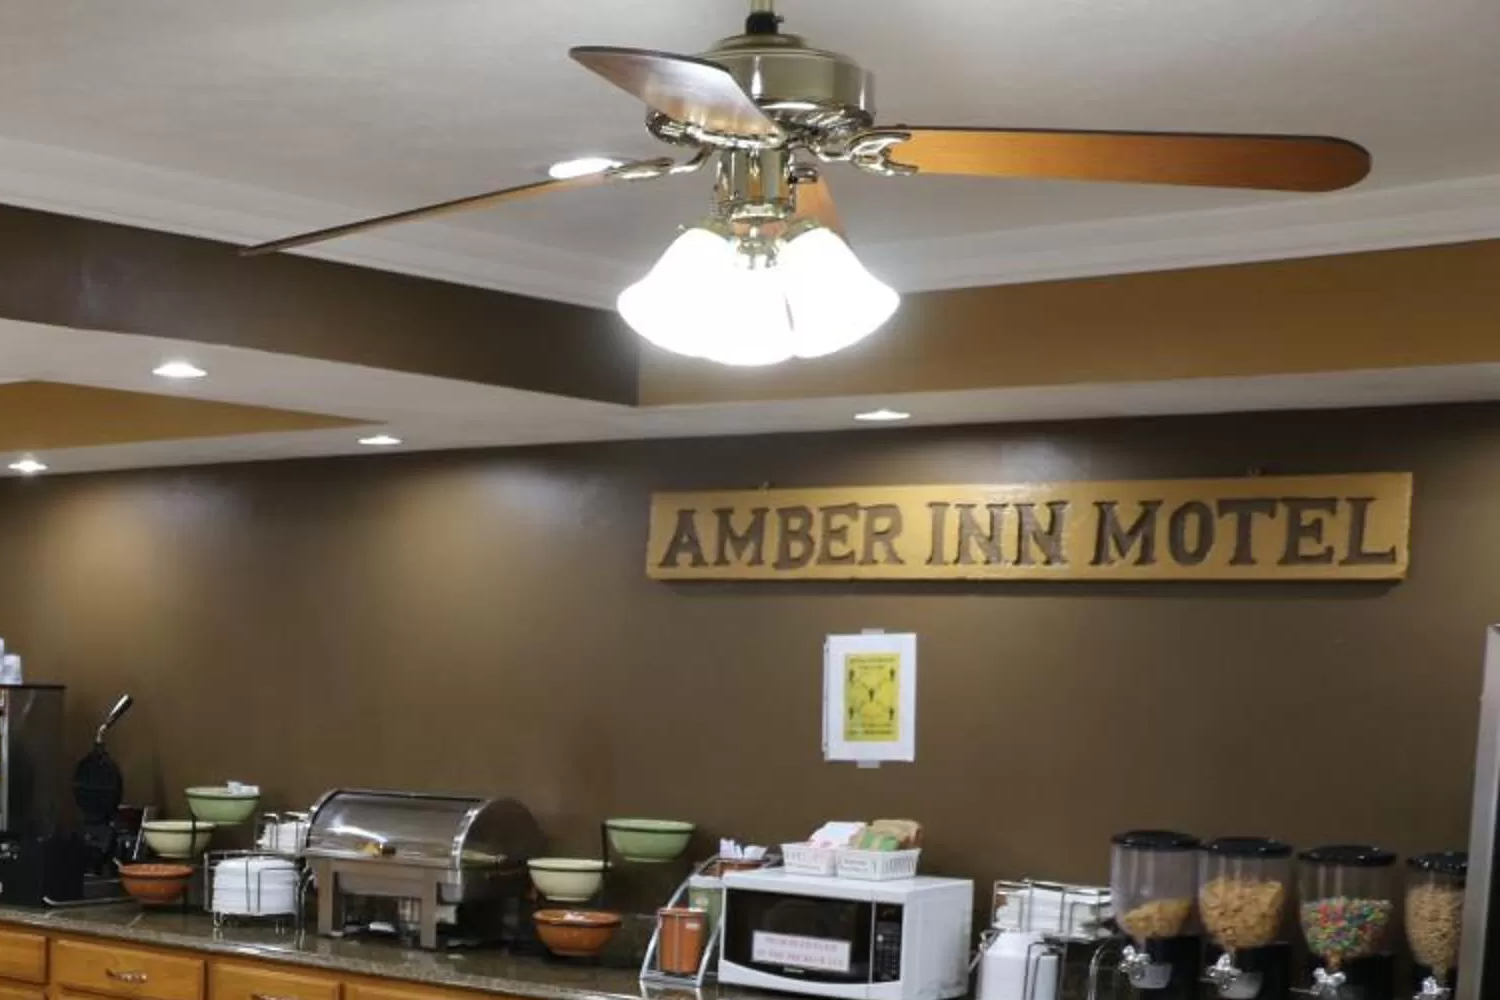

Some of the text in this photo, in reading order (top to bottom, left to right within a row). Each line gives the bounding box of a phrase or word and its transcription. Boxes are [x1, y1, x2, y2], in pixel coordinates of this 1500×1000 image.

[658, 496, 1397, 570] AMBER INN MOTEL
